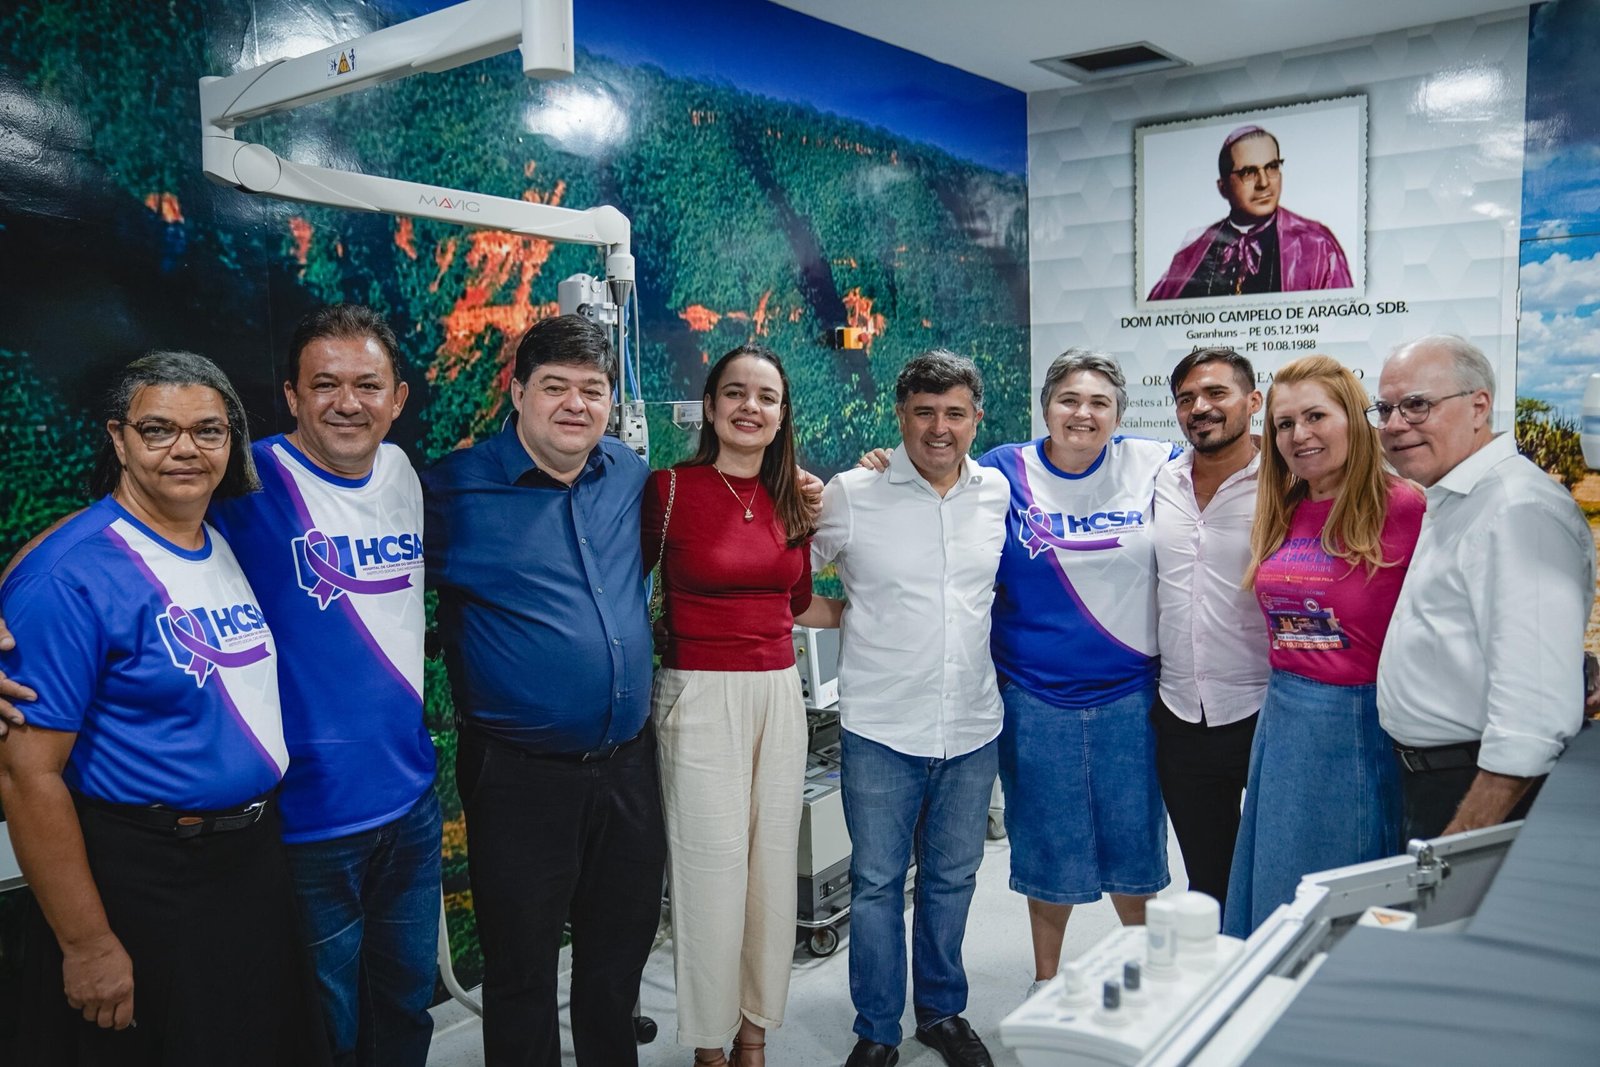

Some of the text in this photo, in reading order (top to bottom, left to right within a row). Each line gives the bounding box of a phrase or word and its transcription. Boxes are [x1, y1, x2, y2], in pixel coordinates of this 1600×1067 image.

[418, 193, 480, 213] MAVIG
[1121, 300, 1409, 328] DOM ANTÔNIO CAMPELO DE ARAGÃO, SDB.
[1186, 323, 1319, 340] Garanhuns PE 05.12.1904
[1246, 341, 1258, 352] PE
[1262, 340, 1316, 351] 10.08.1988
[1142, 375, 1171, 387] ORA
[1120, 417, 1177, 429] ecialmente
[355, 533, 424, 567] HCSA
